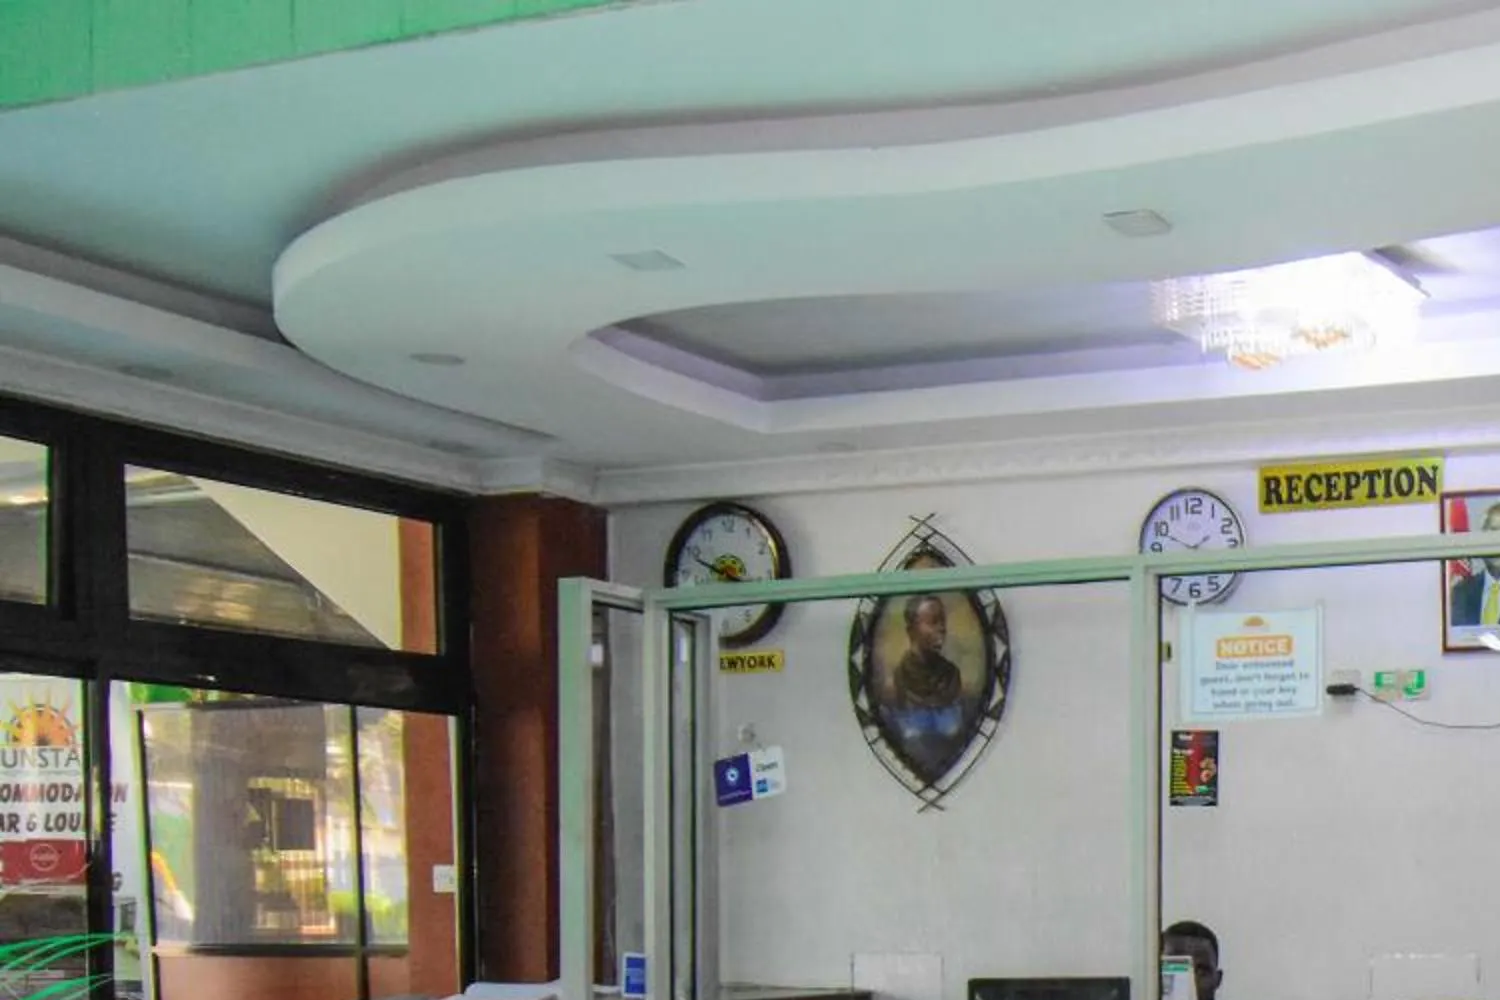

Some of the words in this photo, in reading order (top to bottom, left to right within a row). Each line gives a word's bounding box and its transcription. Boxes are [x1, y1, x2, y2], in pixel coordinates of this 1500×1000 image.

[1263, 465, 1439, 506] RECEPTION
[1169, 505, 1180, 521] 11
[1184, 497, 1203, 515] 12
[1154, 520, 1169, 537] 10
[1220, 517, 1233, 535] 2
[1171, 577, 1182, 594] 7
[1189, 582, 1201, 598] 6
[1207, 575, 1220, 592] 5
[1219, 639, 1289, 655] NOTICE
